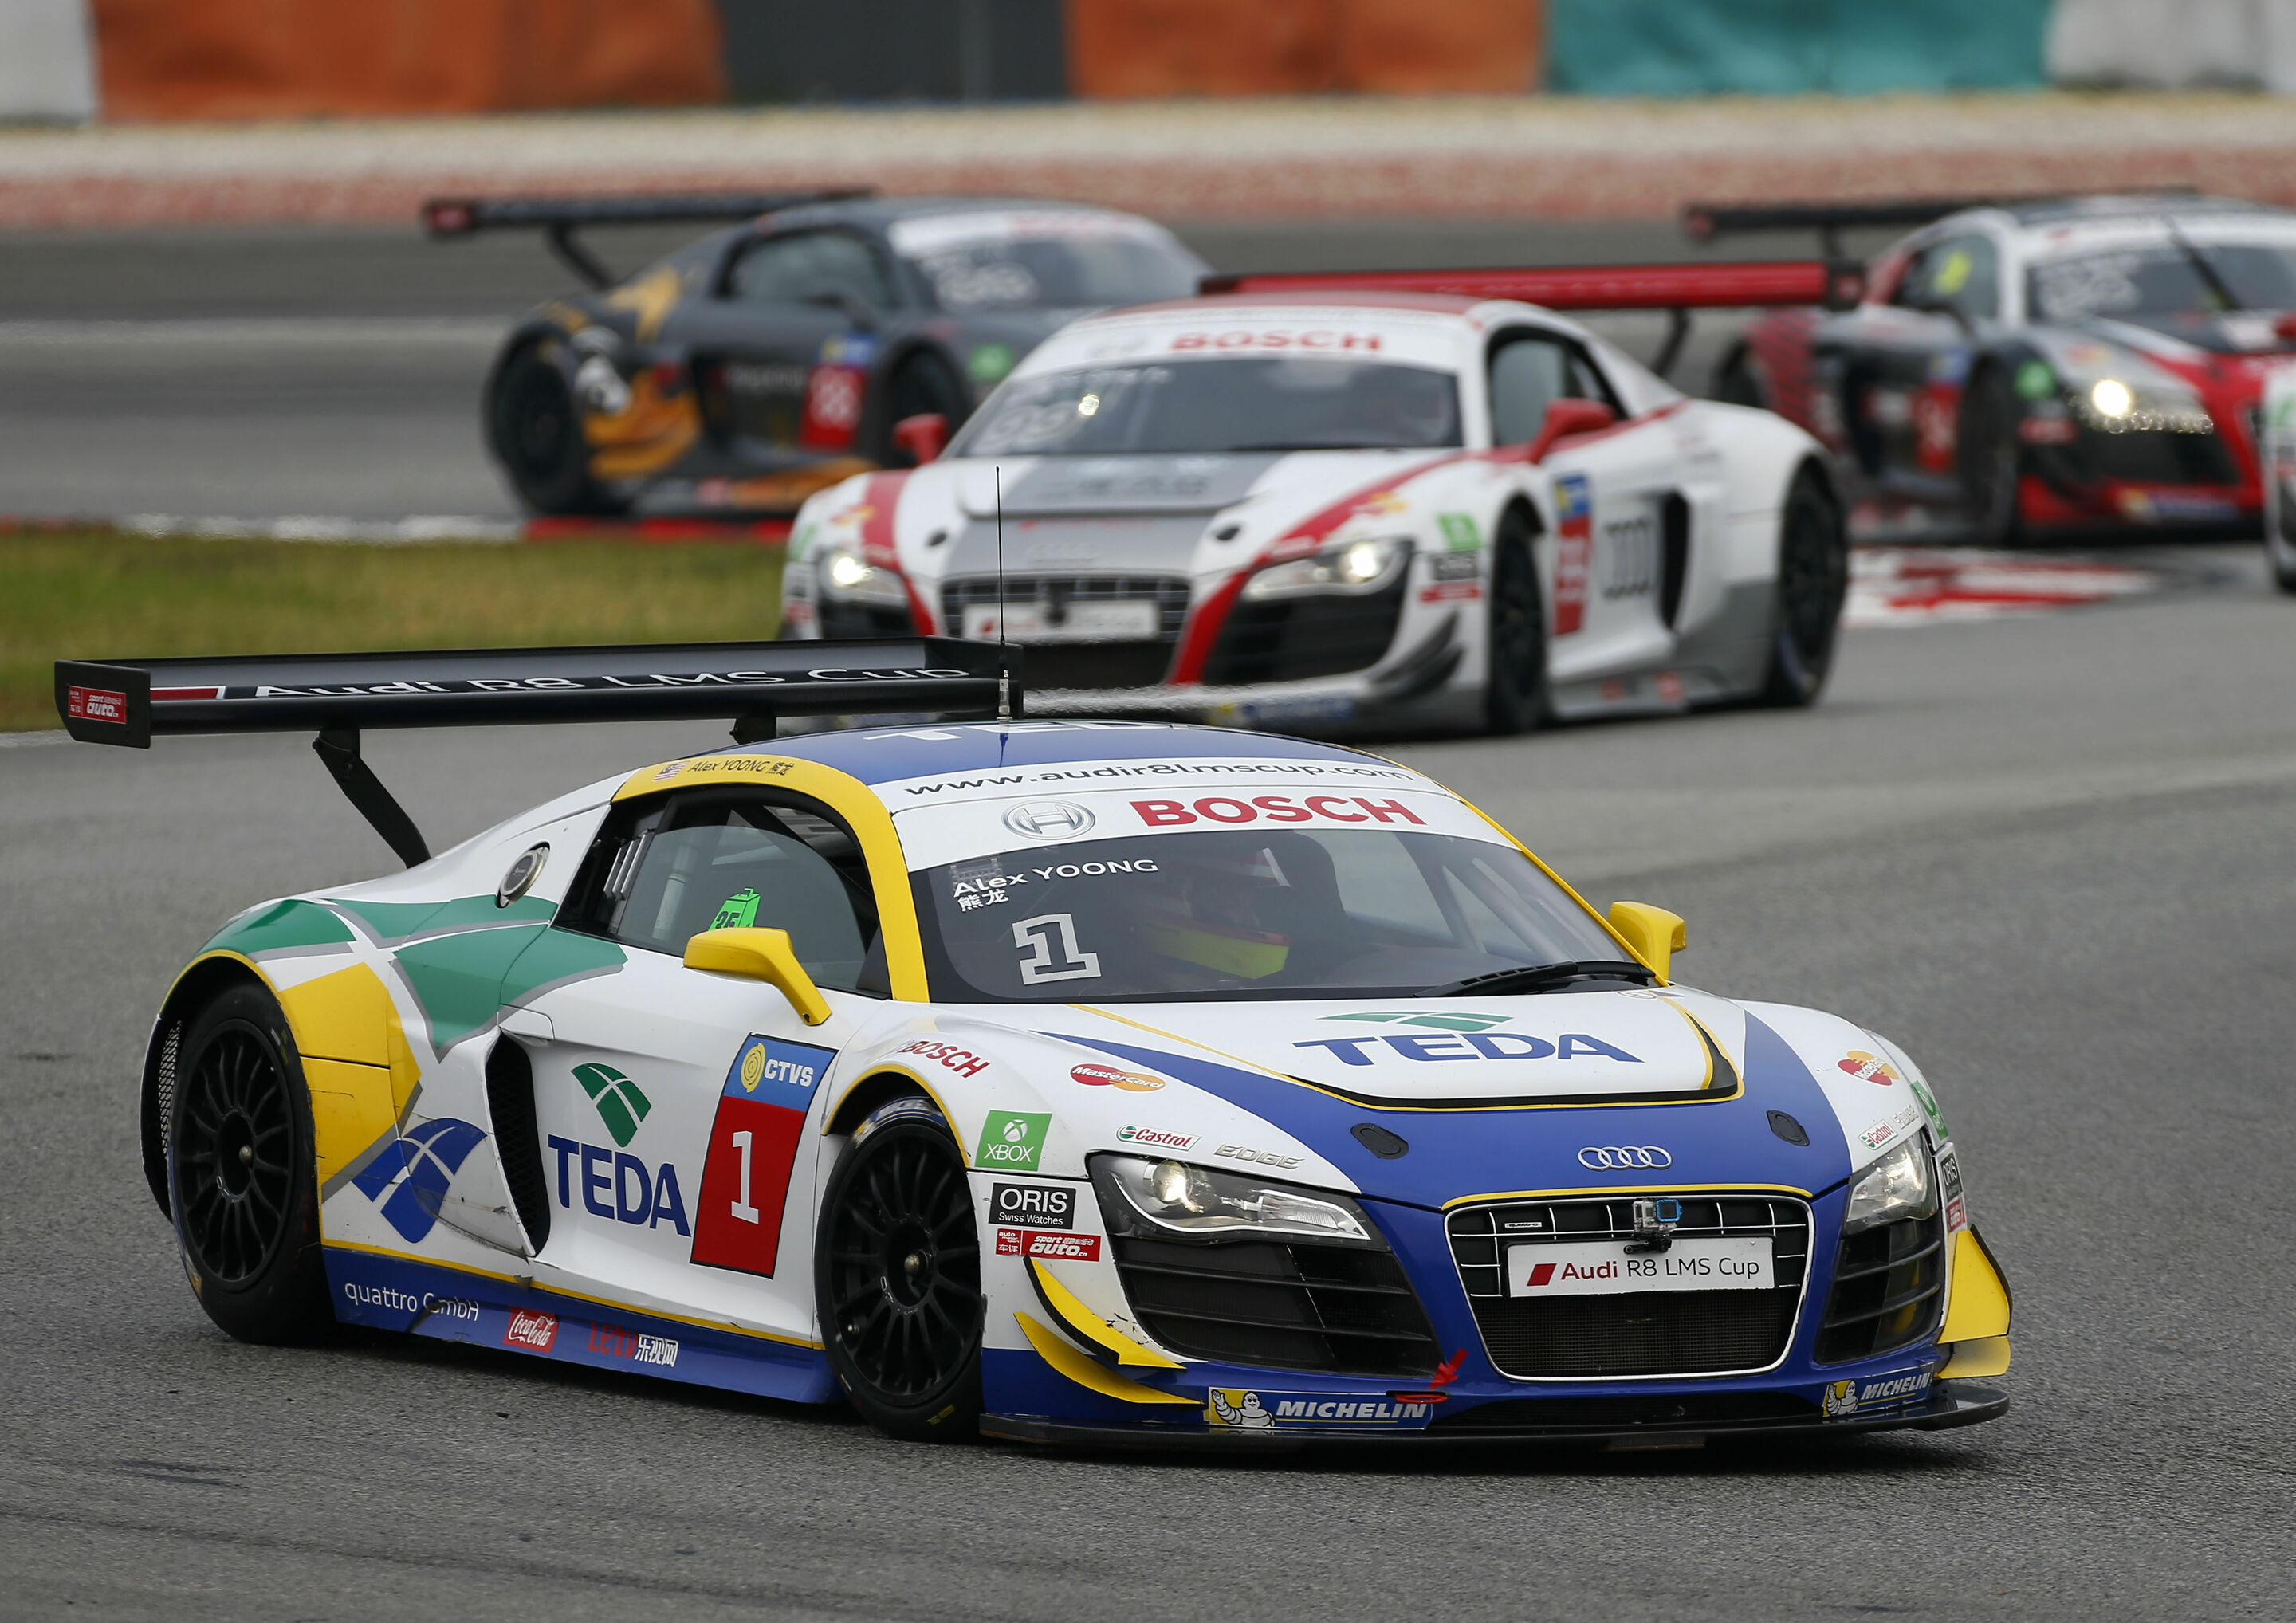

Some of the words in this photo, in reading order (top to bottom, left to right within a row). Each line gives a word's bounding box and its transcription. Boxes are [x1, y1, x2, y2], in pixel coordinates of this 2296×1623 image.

[1170, 330, 1382, 351] BOSCH
[255, 681, 450, 697] Audi
[468, 677, 585, 690] R8
[603, 671, 785, 687] LMS
[687, 761, 720, 772] Alex
[721, 760, 771, 772] YOONG
[904, 762, 1414, 796] www.audir8lmscup.com
[1128, 796, 1426, 827] BOSCH
[1032, 859, 1158, 880] YOONG
[957, 888, 1009, 912] 熊龙
[1012, 914, 1102, 985] 1
[898, 1040, 991, 1079] BOSCH
[1292, 1033, 1645, 1067] TEDA
[764, 1059, 815, 1087] CTVS
[1071, 1066, 1164, 1089] MasterCard
[1135, 1128, 1193, 1148] Castrol
[1867, 1122, 1895, 1145] Castrol
[984, 1144, 1034, 1162] XBOX
[1213, 1143, 1305, 1170] EDGE
[548, 1134, 692, 1237] TEDA
[731, 1130, 759, 1224] 1
[999, 1188, 1068, 1214] ORIS
[998, 1212, 1024, 1223] Swiss
[1026, 1214, 1063, 1225] Watches
[1034, 1235, 1062, 1244] sport
[1561, 1261, 1618, 1280] Audi
[1626, 1259, 1657, 1277] R8
[1665, 1257, 1712, 1276] LMS
[1718, 1257, 1760, 1279] Cup
[344, 1282, 418, 1313] quattro
[634, 1333, 678, 1368] 乐视网
[1861, 1373, 1931, 1401] MICHELIN
[1276, 1401, 1427, 1418] MICHELIN
